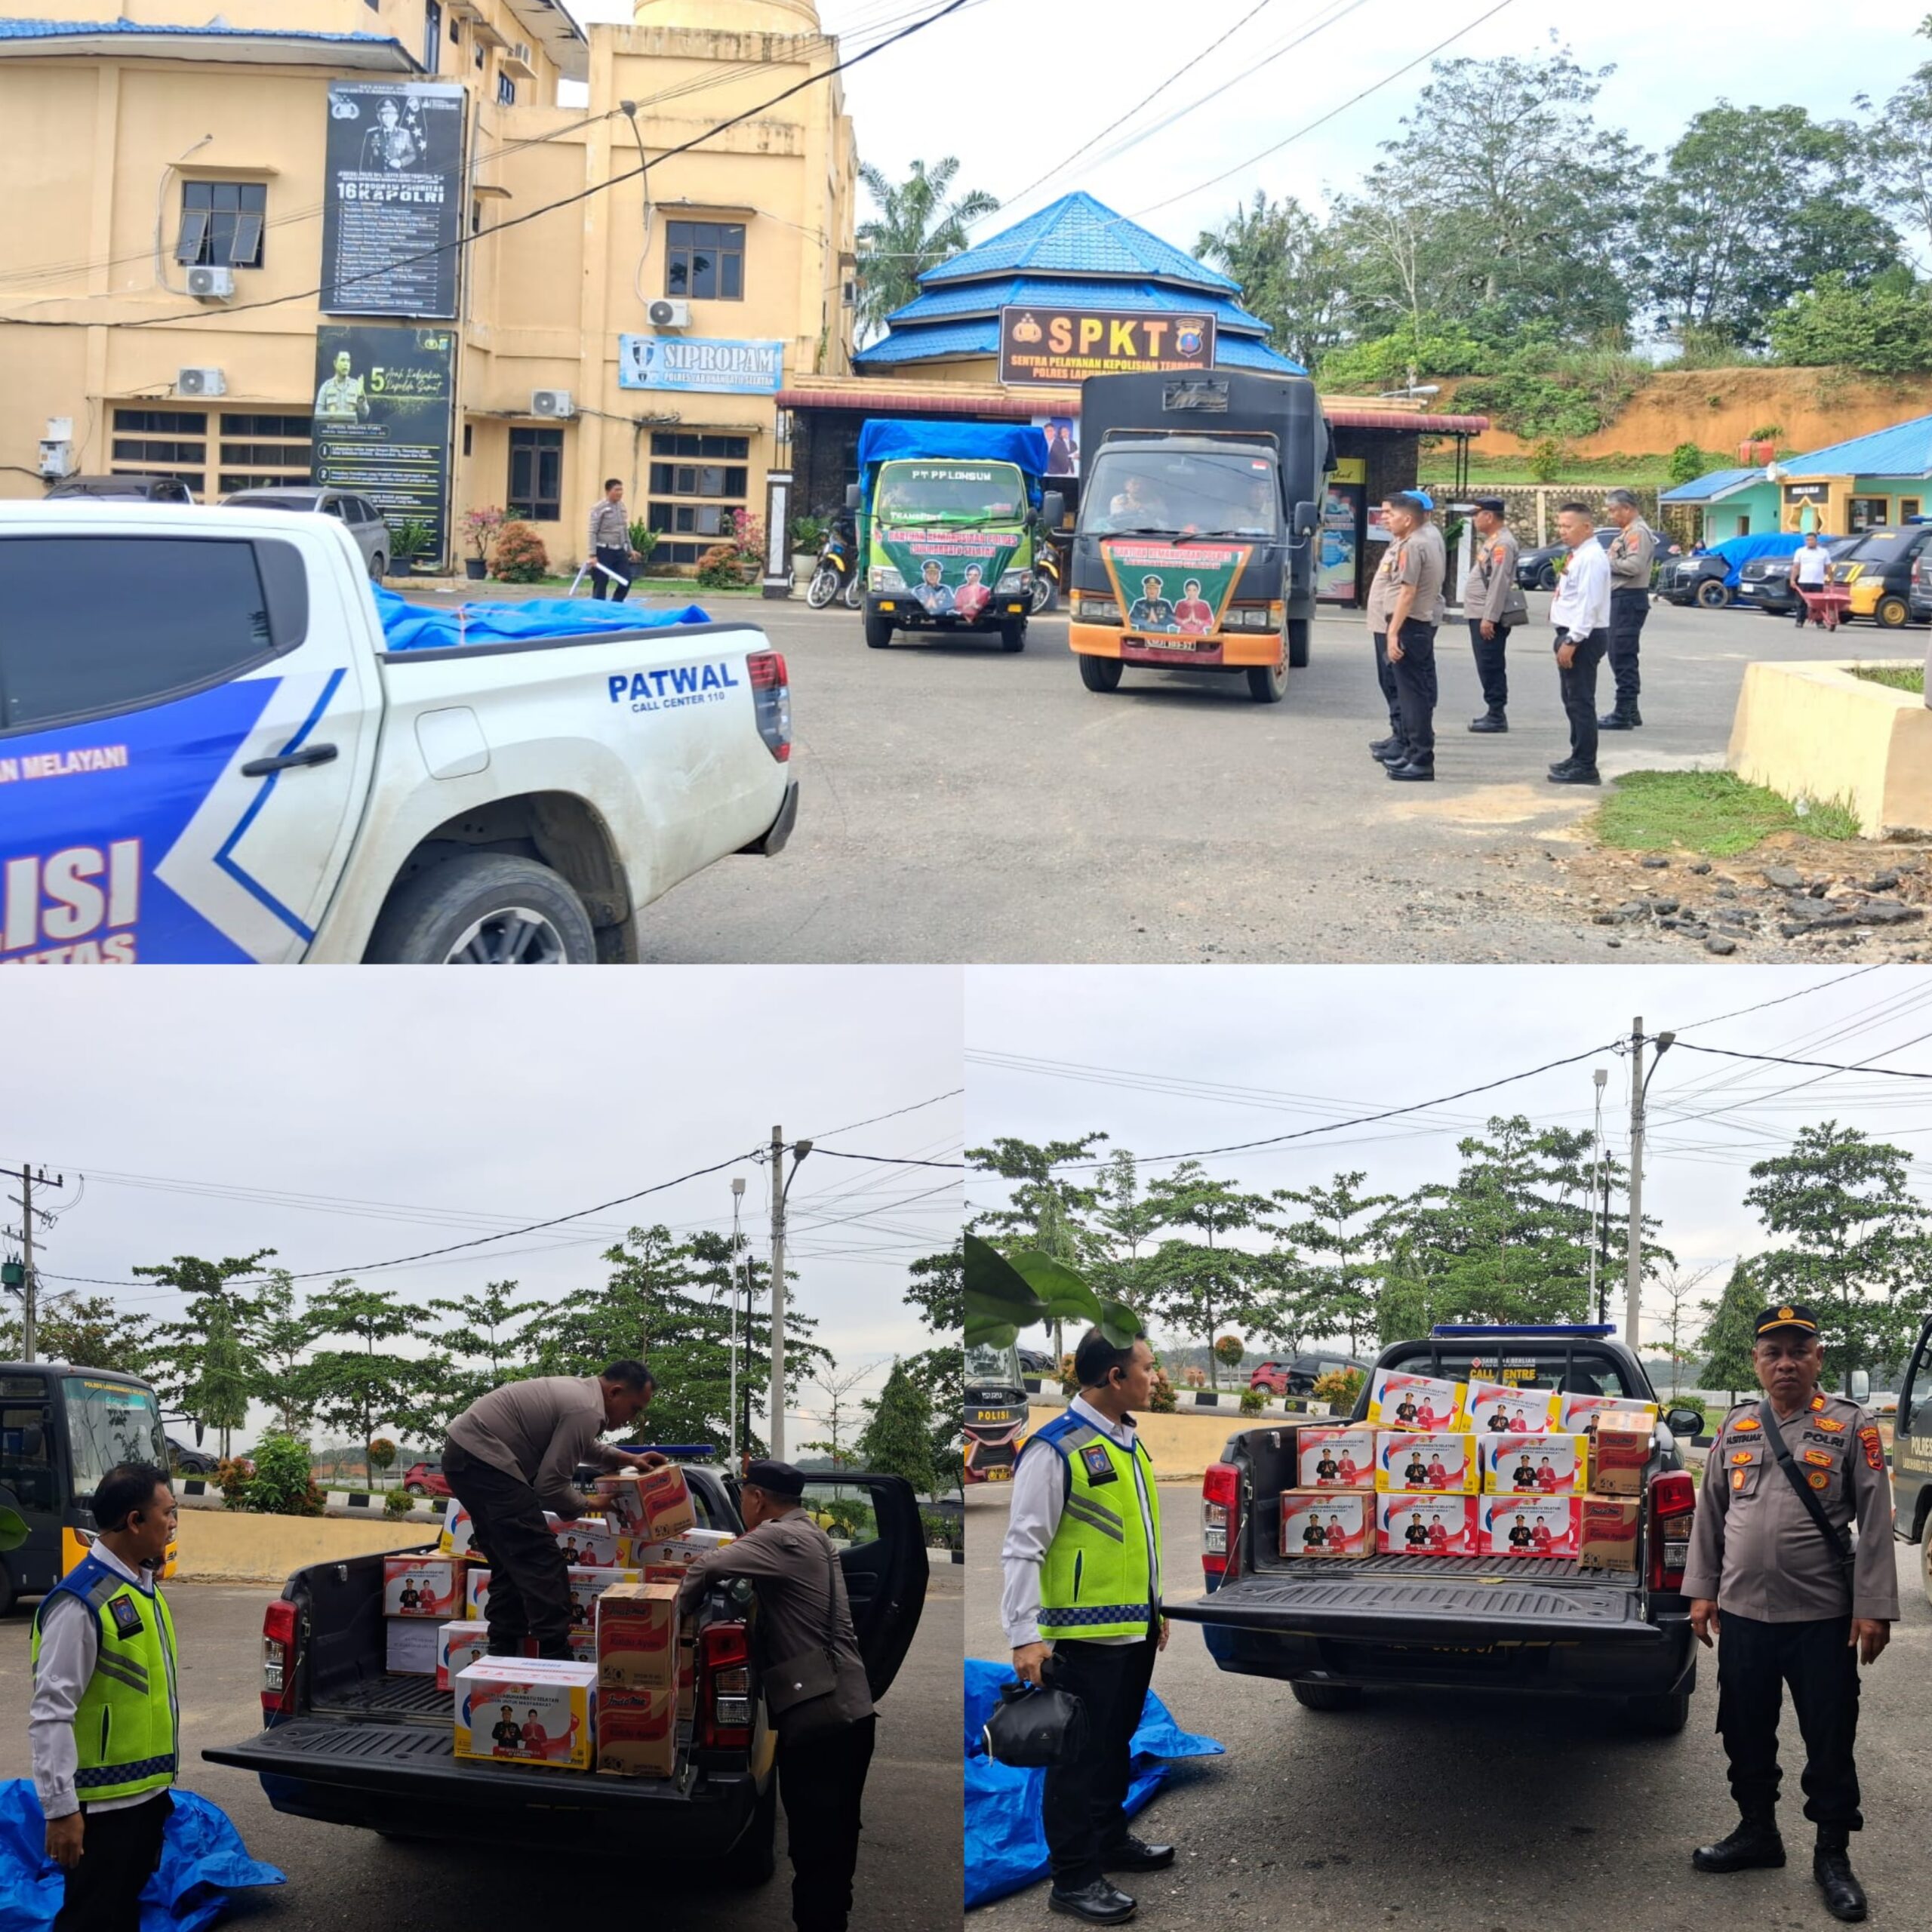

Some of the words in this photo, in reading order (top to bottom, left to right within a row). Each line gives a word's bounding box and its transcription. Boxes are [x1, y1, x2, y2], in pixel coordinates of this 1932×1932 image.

[337, 183, 357, 199] 16
[358, 189, 445, 203] KAPOLRI
[1048, 317, 1168, 357] SPKT
[664, 344, 774, 373] SIPROPAM
[1011, 355, 1047, 367] SENTRA
[1049, 357, 1102, 369] PELAYANAN
[1103, 358, 1158, 371] KEPOLISIAN
[371, 367, 385, 392] 5
[1032, 368, 1068, 379] POLRES
[608, 663, 739, 703] PATWAL
[632, 702, 660, 712] CALL
[663, 695, 705, 709] CENTER
[708, 691, 724, 703] 110
[23, 744, 128, 779] MELAYANI
[0, 838, 140, 950] ISI
[1470, 1369, 1494, 1380] CALL
[1496, 1369, 1536, 1380] ENTRE
[978, 1410, 1009, 1420] POLISI
[1803, 1432, 1845, 1447] POLRI
